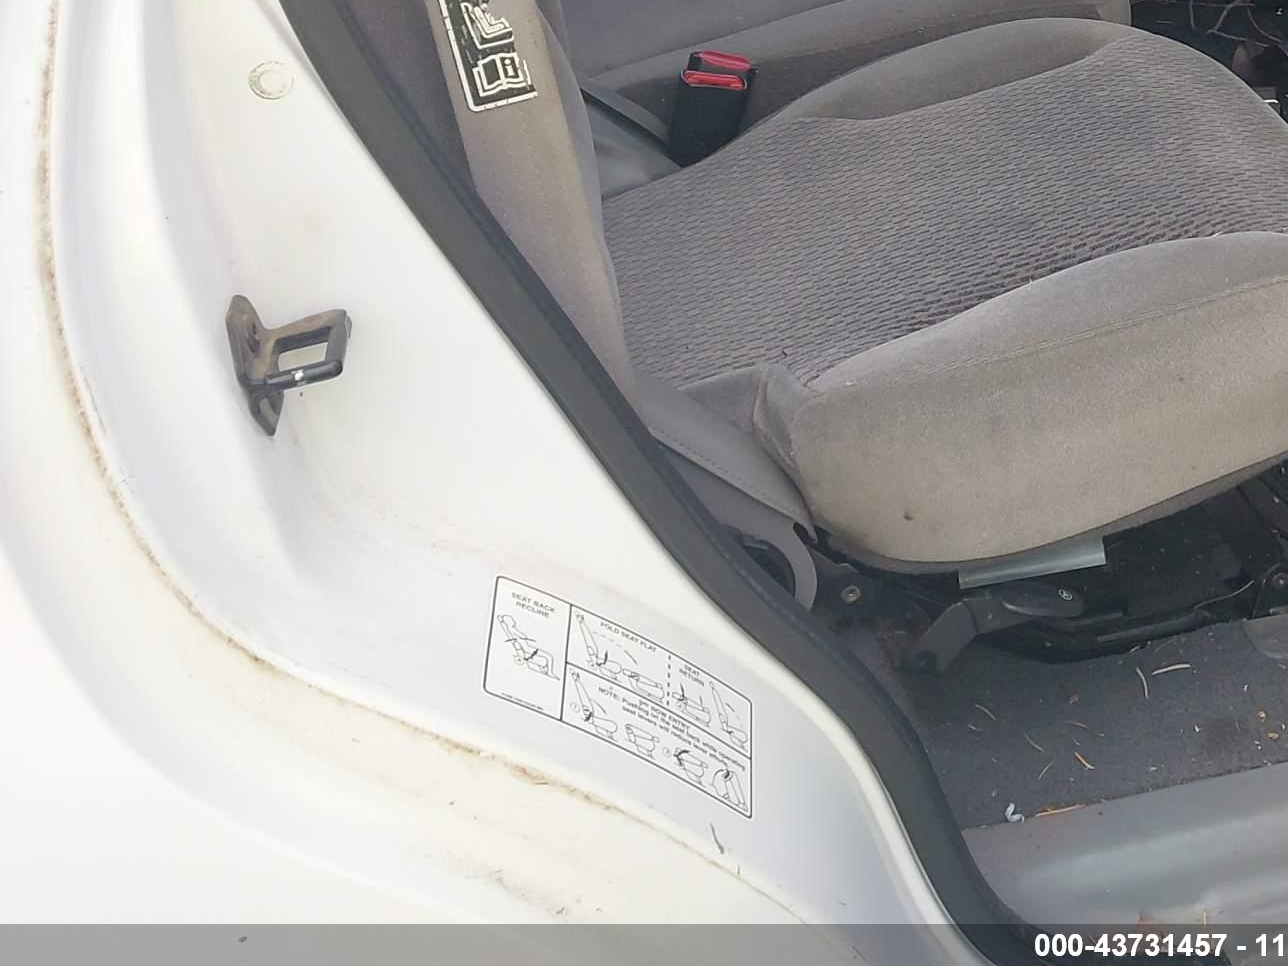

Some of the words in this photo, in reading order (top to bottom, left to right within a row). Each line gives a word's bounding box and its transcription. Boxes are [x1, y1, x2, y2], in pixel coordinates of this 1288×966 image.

[511, 592, 532, 604] SEAT
[533, 601, 556, 613] BACK
[515, 601, 550, 619] RECLINE
[600, 621, 620, 635] FOLD
[620, 631, 639, 643] SEAT
[640, 640, 657, 653] FLAT
